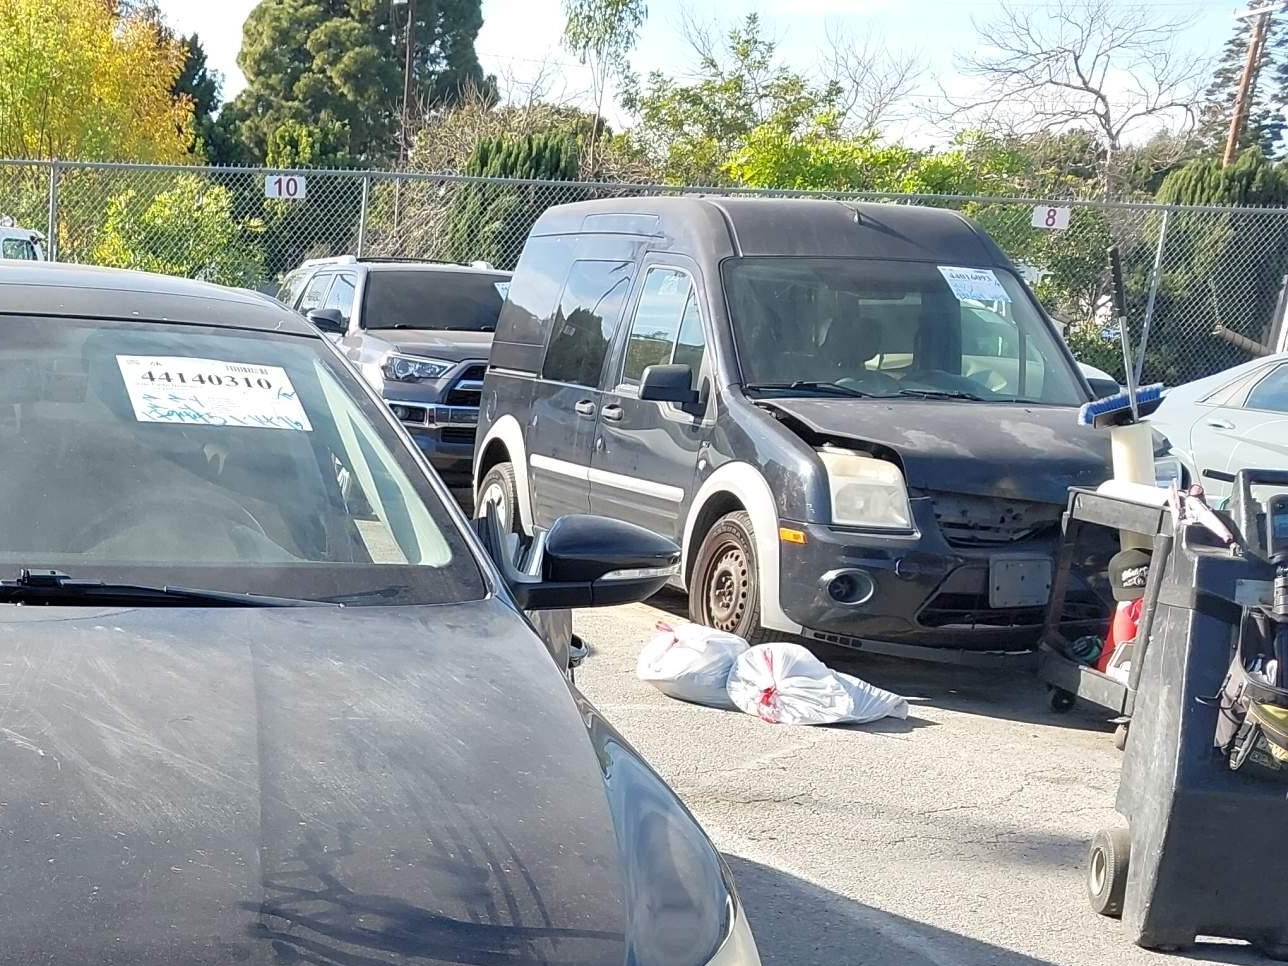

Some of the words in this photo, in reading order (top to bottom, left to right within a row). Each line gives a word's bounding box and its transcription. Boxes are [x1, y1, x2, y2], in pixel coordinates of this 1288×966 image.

[273, 177, 298, 197] 10
[1045, 208, 1057, 227] 8
[141, 370, 273, 391] 44140310
